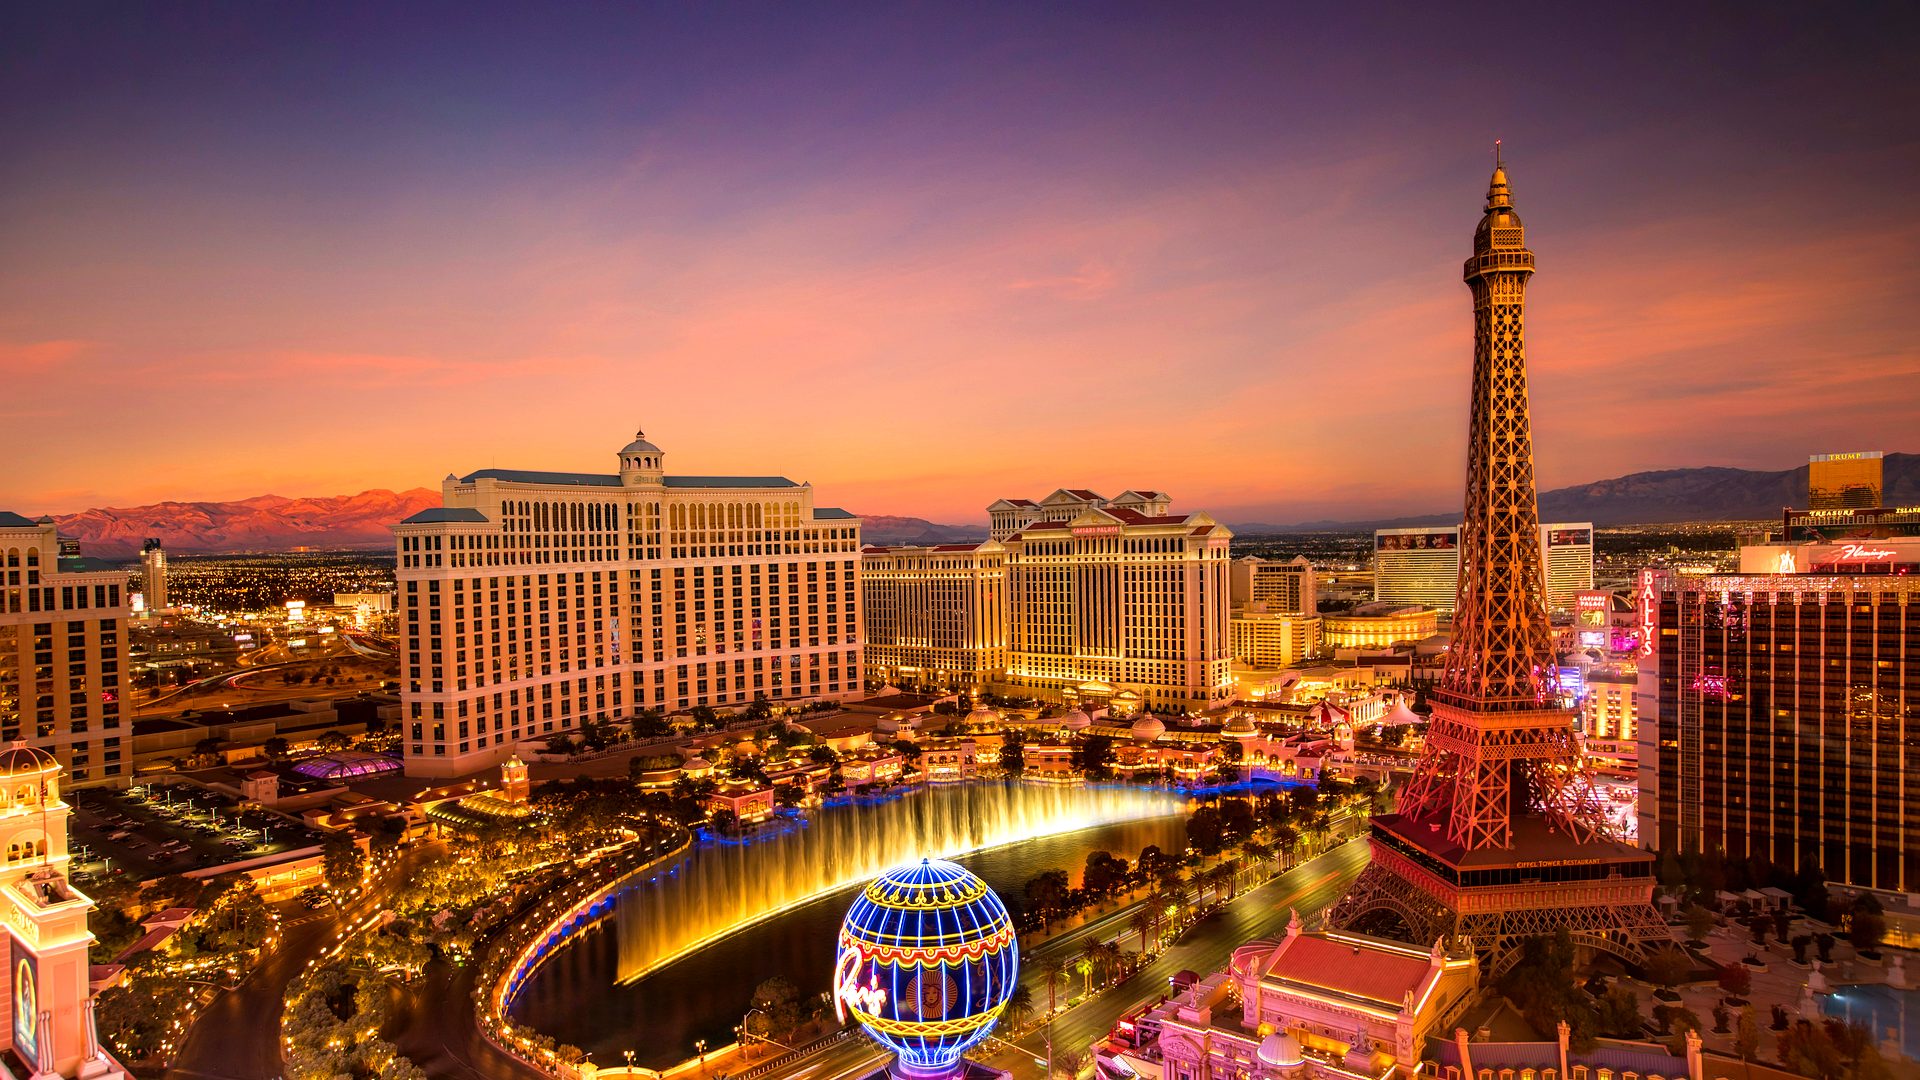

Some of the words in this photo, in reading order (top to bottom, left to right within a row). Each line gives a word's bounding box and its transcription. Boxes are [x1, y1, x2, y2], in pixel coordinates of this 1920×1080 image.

[1829, 452, 1861, 461] TRUMP
[1808, 509, 1855, 517] TREASURE
[1841, 544, 1897, 560] Flamingo
[1538, 860, 1561, 868] TOWER
[1563, 858, 1601, 867] RESTAURANT
